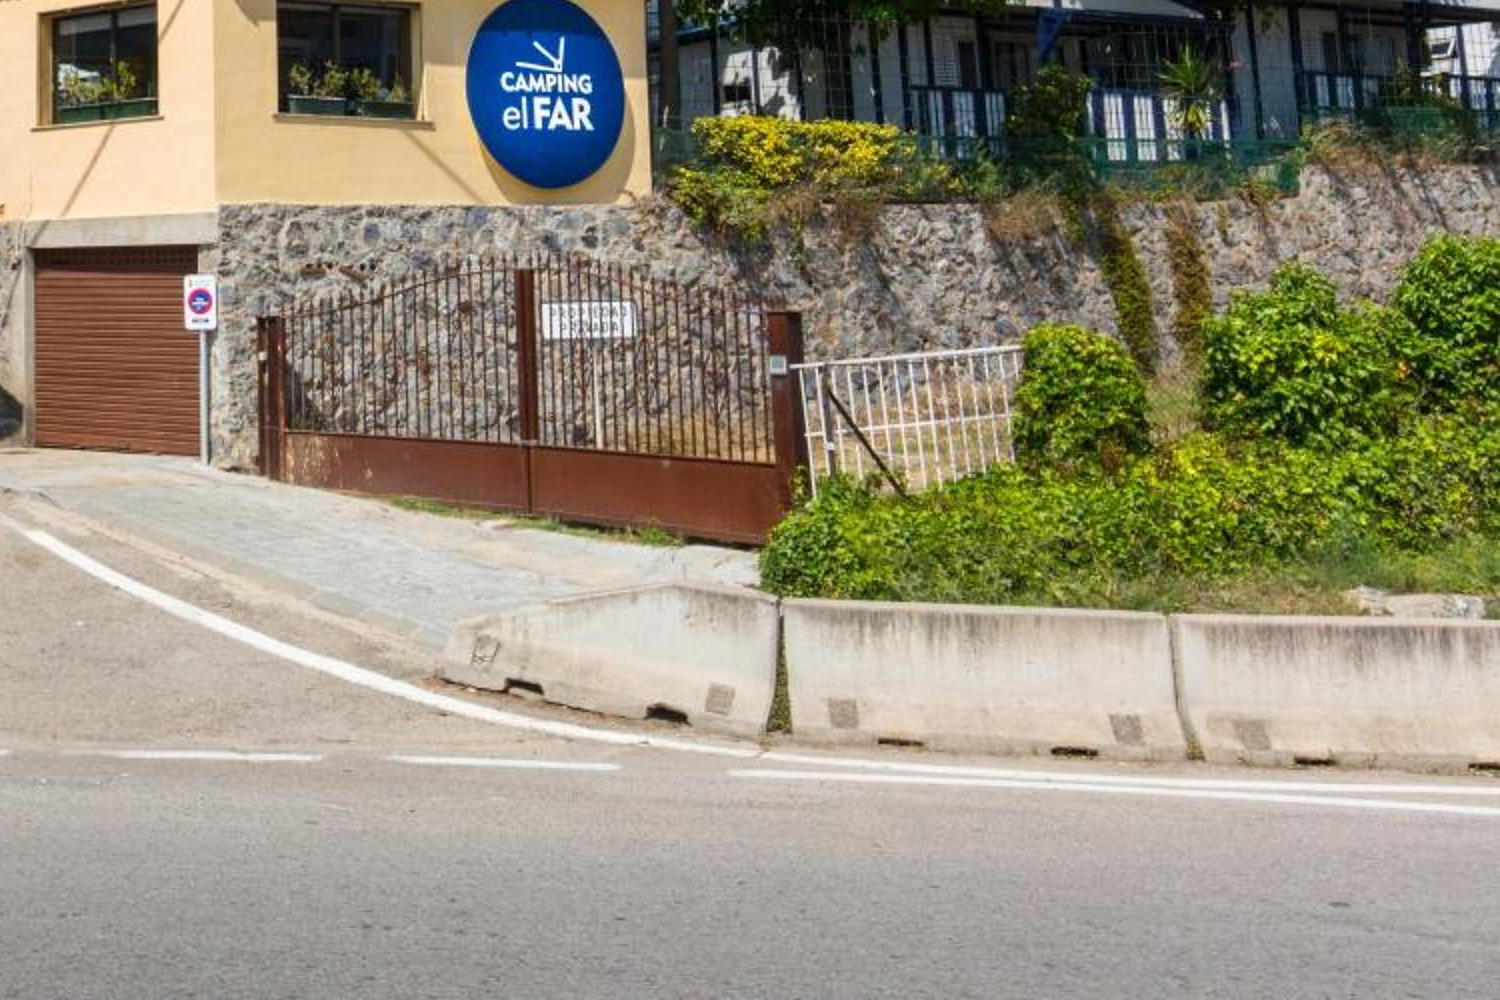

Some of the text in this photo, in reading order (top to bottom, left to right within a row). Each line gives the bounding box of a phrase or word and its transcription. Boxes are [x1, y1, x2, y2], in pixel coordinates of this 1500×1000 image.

[500, 71, 593, 95] CAMPING
[532, 95, 596, 131] FAR
[550, 305, 627, 318] PROPEDAD
[560, 319, 619, 332] PRVADA
